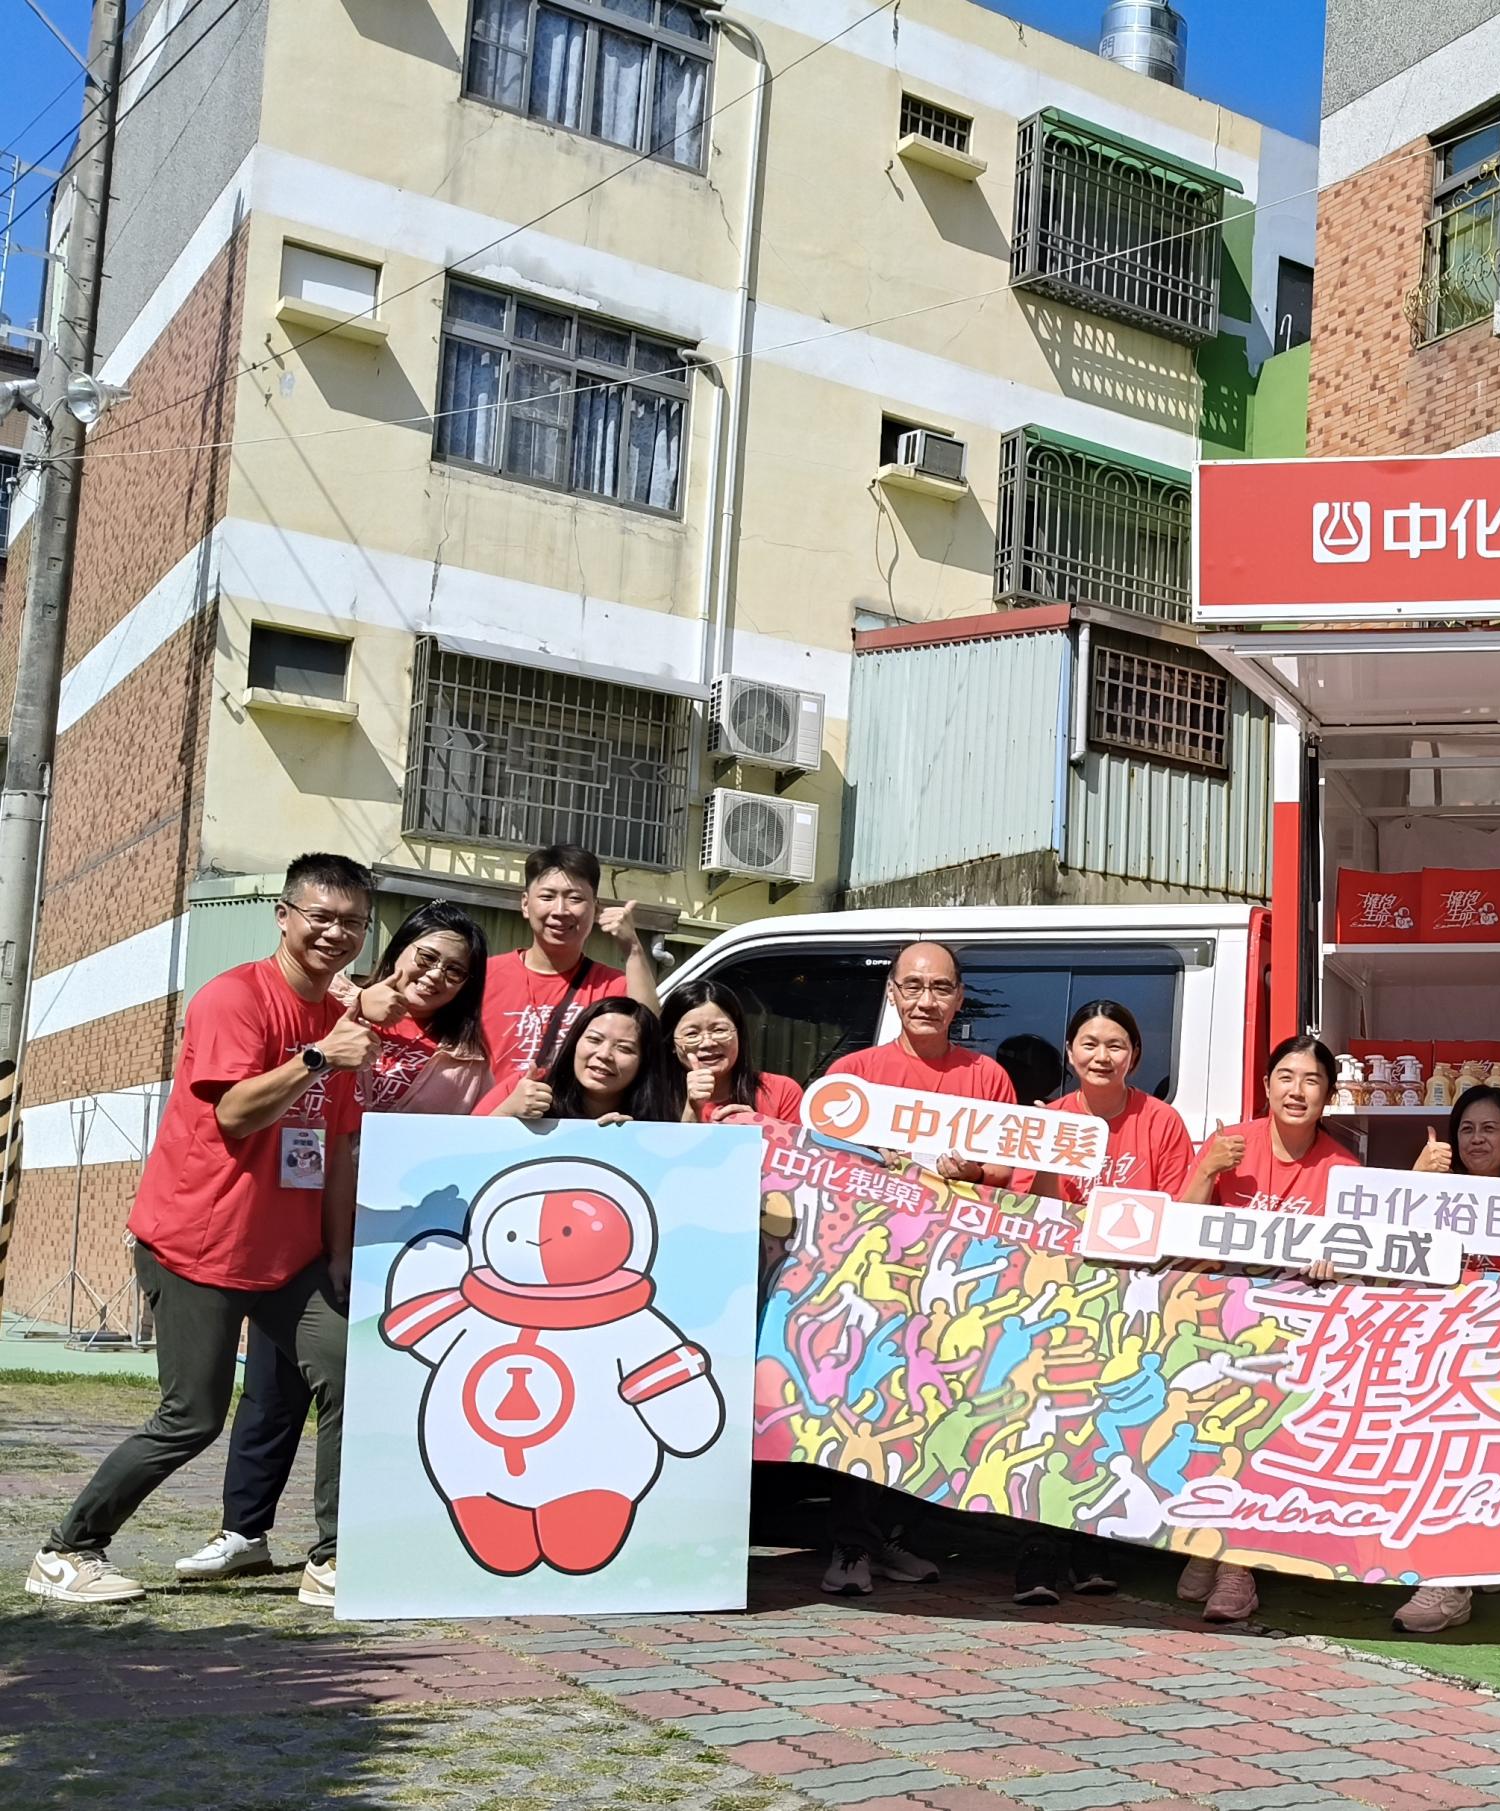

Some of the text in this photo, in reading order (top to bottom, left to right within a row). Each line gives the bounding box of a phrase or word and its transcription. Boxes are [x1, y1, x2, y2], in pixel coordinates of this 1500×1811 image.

[890, 1100, 1101, 1169] 中化銀髮
[770, 1147, 924, 1213] 中化製藥
[1199, 1212, 1433, 1277] 中化合成
[1168, 1484, 1391, 1528] Embrace
